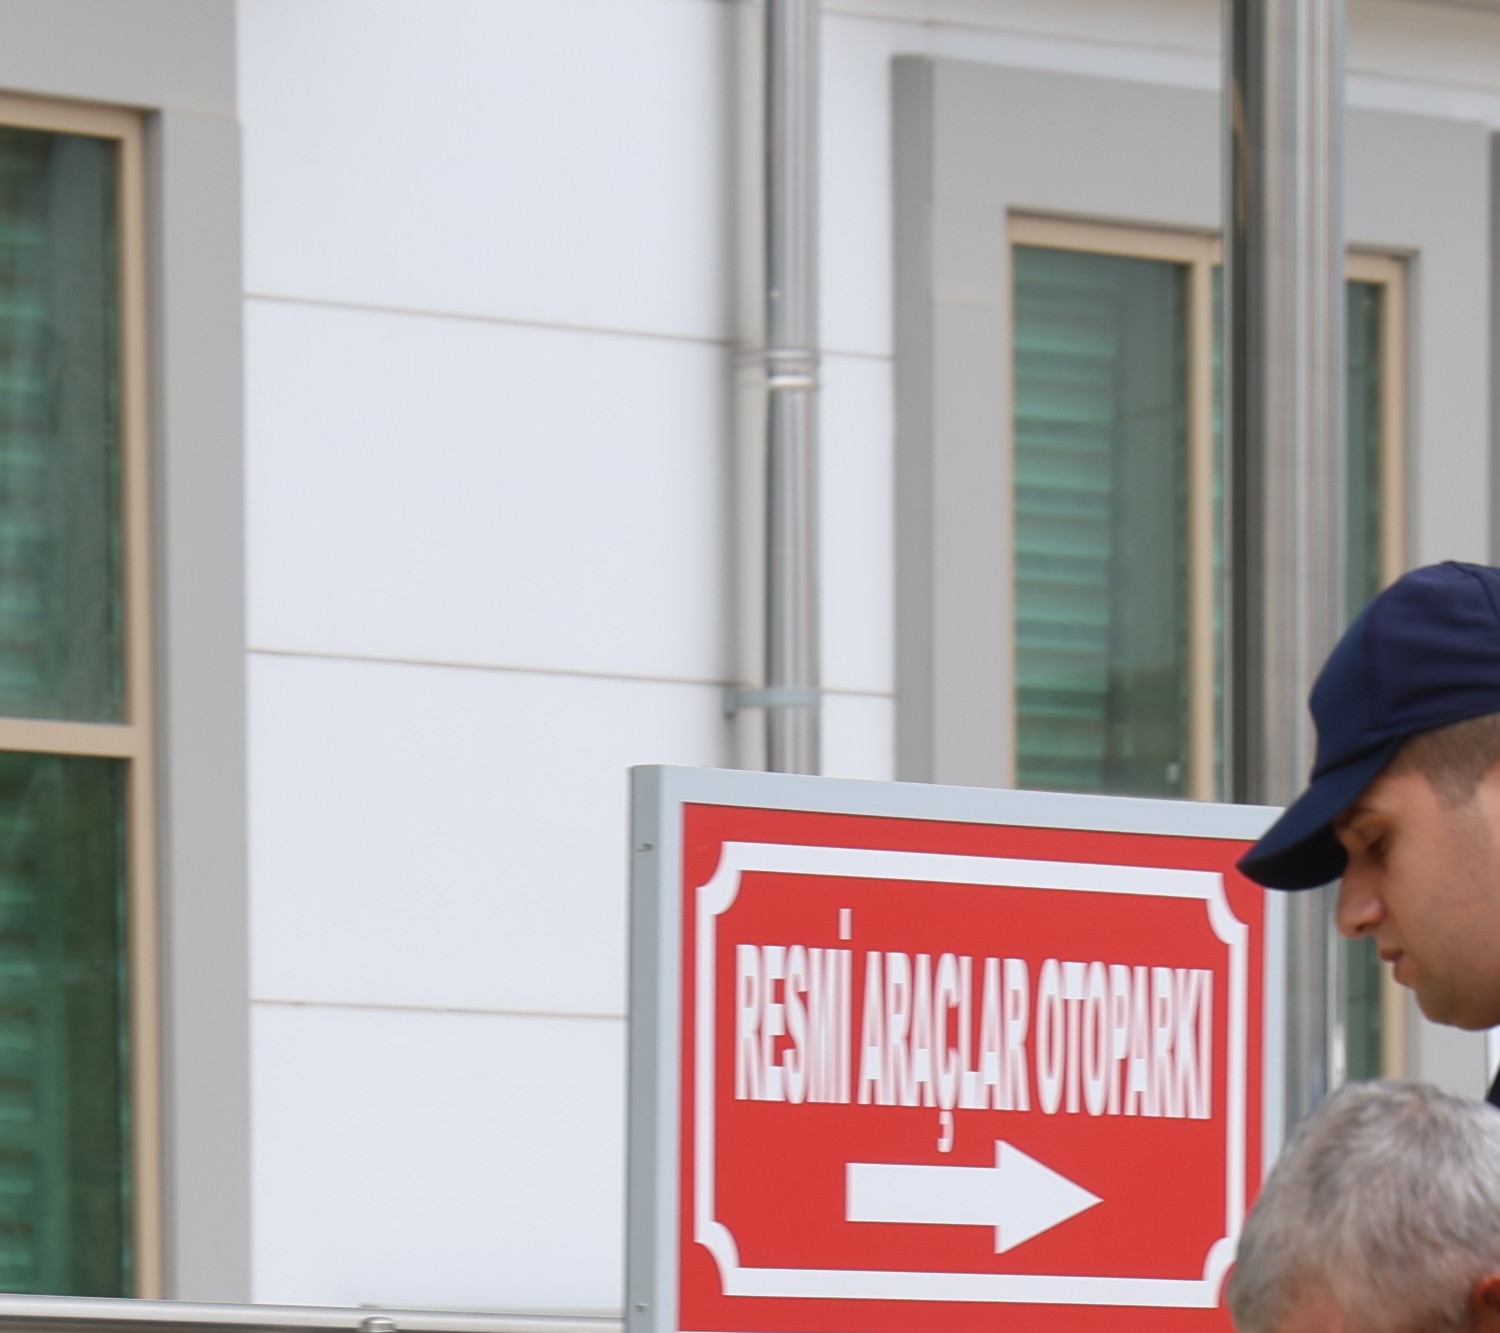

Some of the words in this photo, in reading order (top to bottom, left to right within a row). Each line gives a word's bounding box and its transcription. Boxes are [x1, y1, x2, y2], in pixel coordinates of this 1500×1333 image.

[735, 907, 852, 1104] RESMİ
[858, 951, 1030, 1153] ARAÇLAR
[1036, 958, 1213, 1120] OTOPARKI
